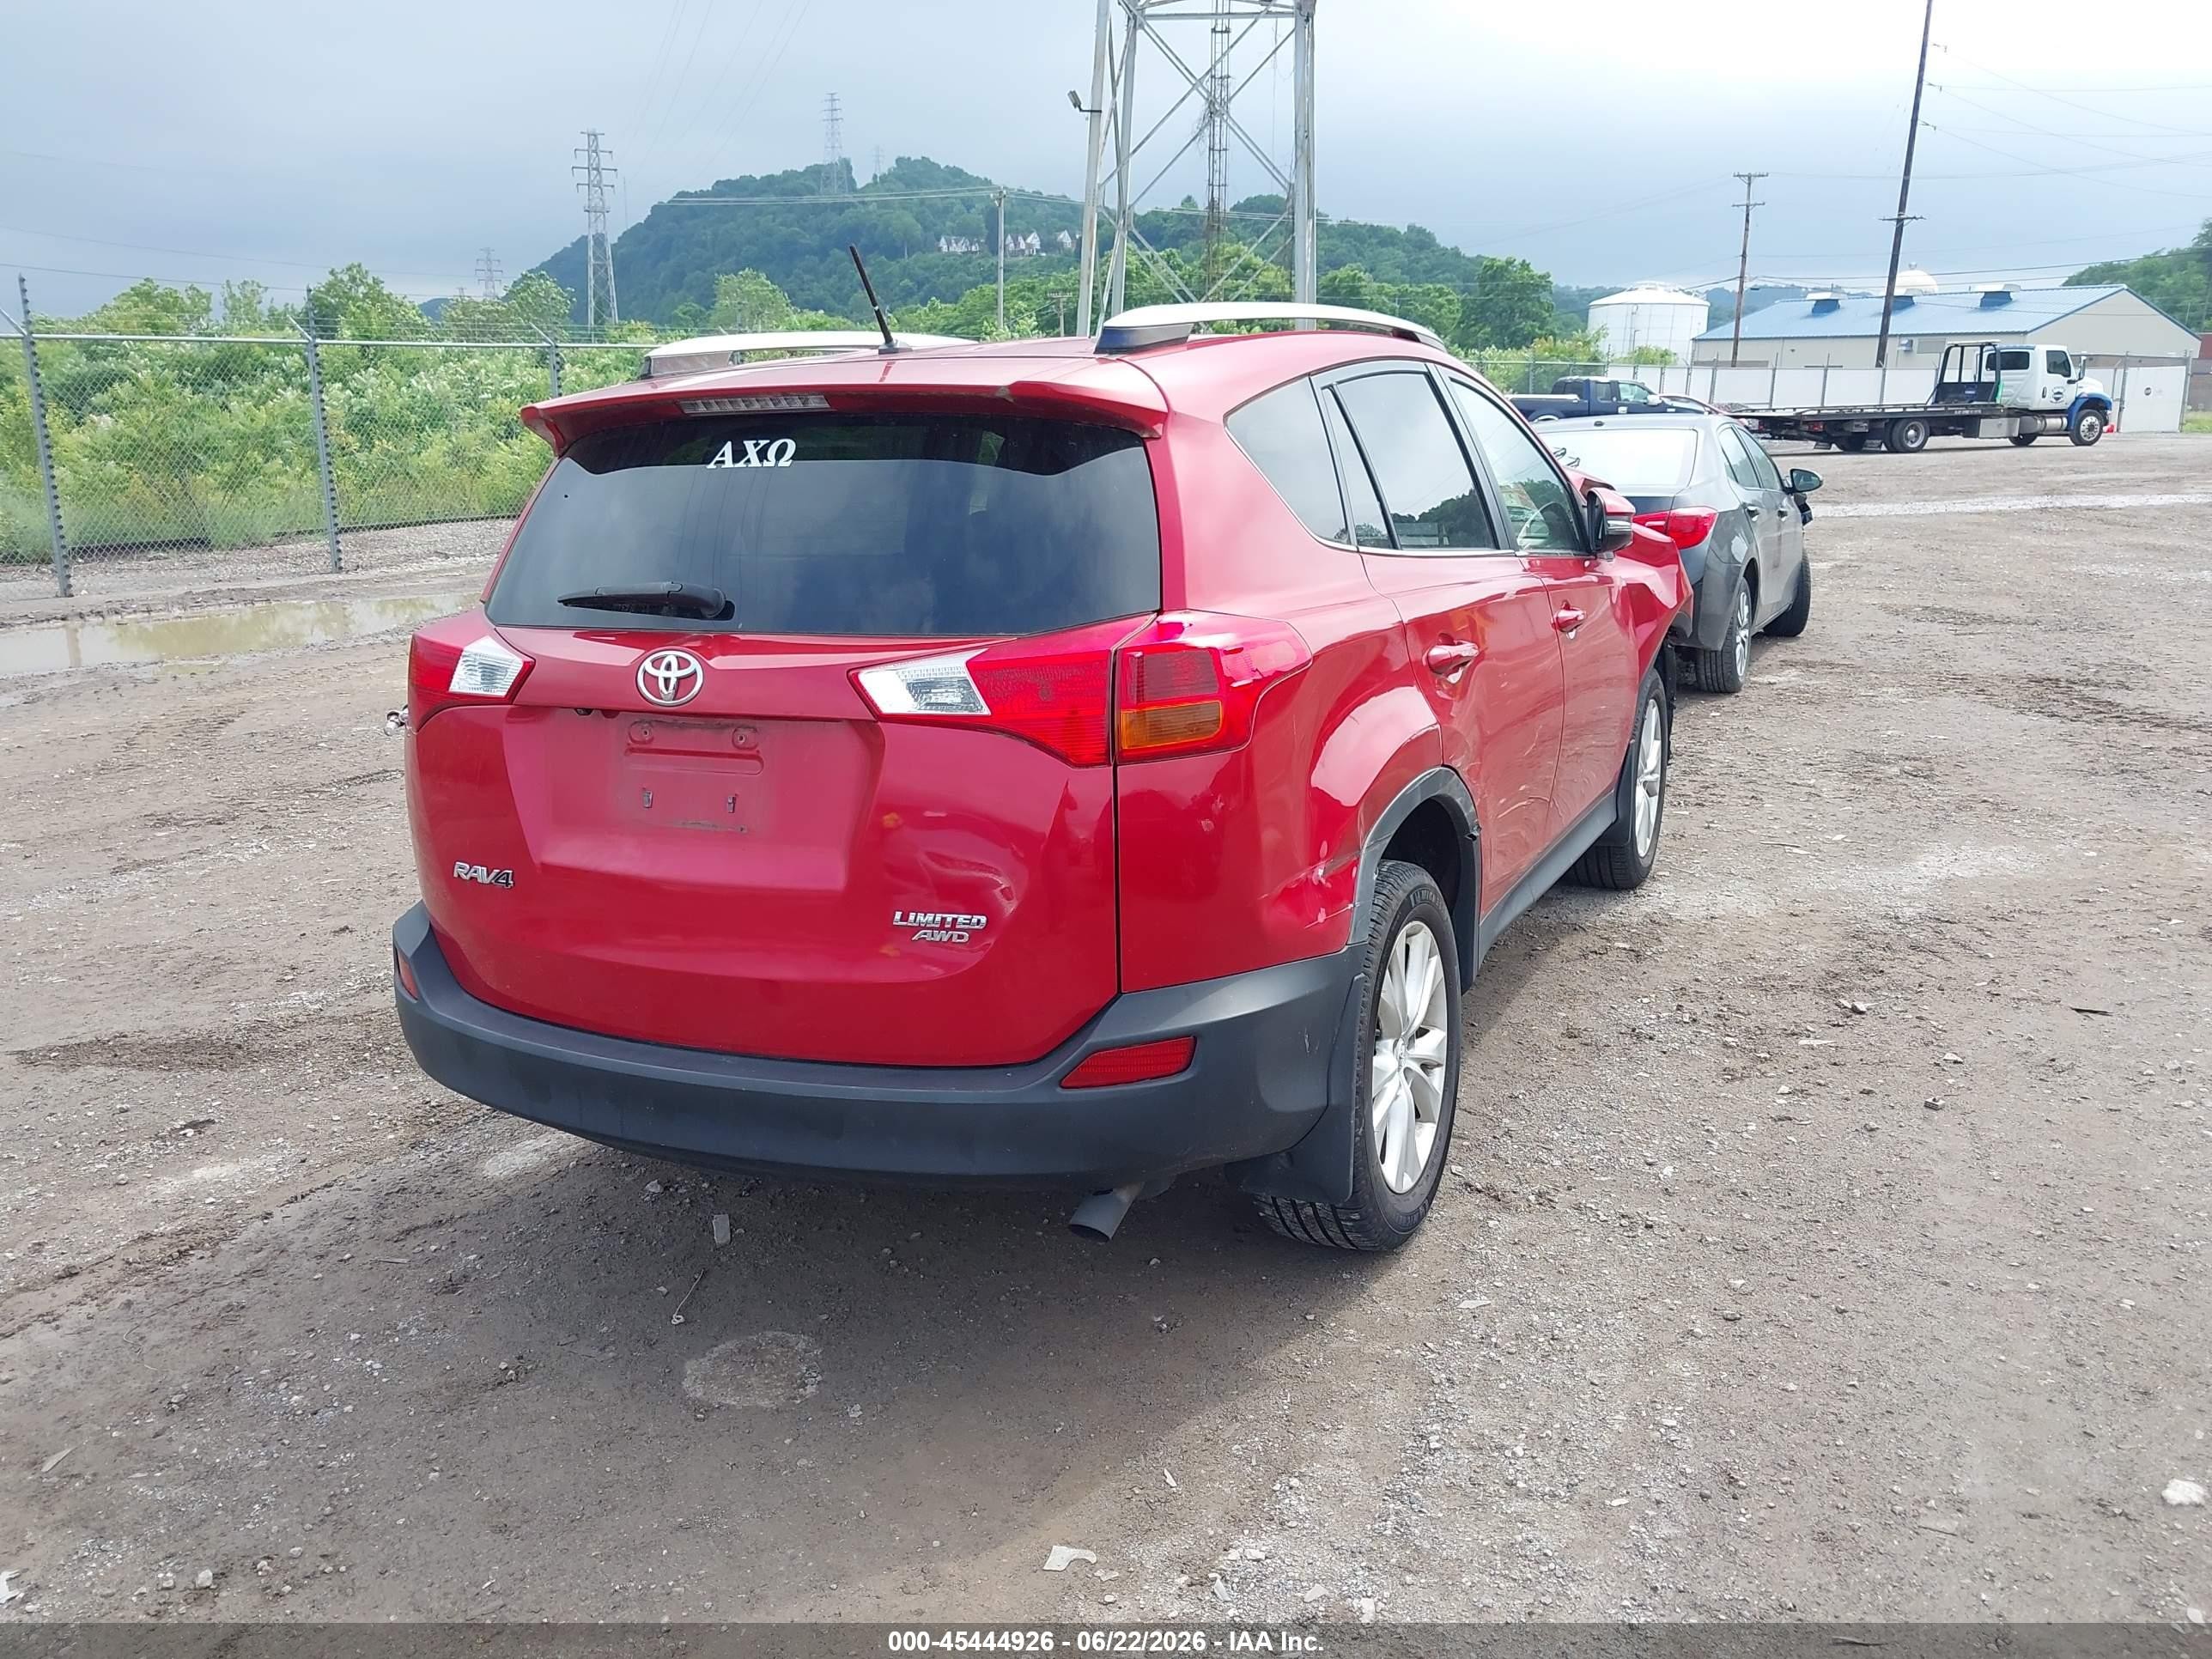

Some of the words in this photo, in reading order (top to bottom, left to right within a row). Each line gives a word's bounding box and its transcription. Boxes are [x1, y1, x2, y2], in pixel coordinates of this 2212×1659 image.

[453, 861, 514, 889] RAV4
[893, 911, 987, 929] LIMITED
[911, 930, 969, 943] AWD
